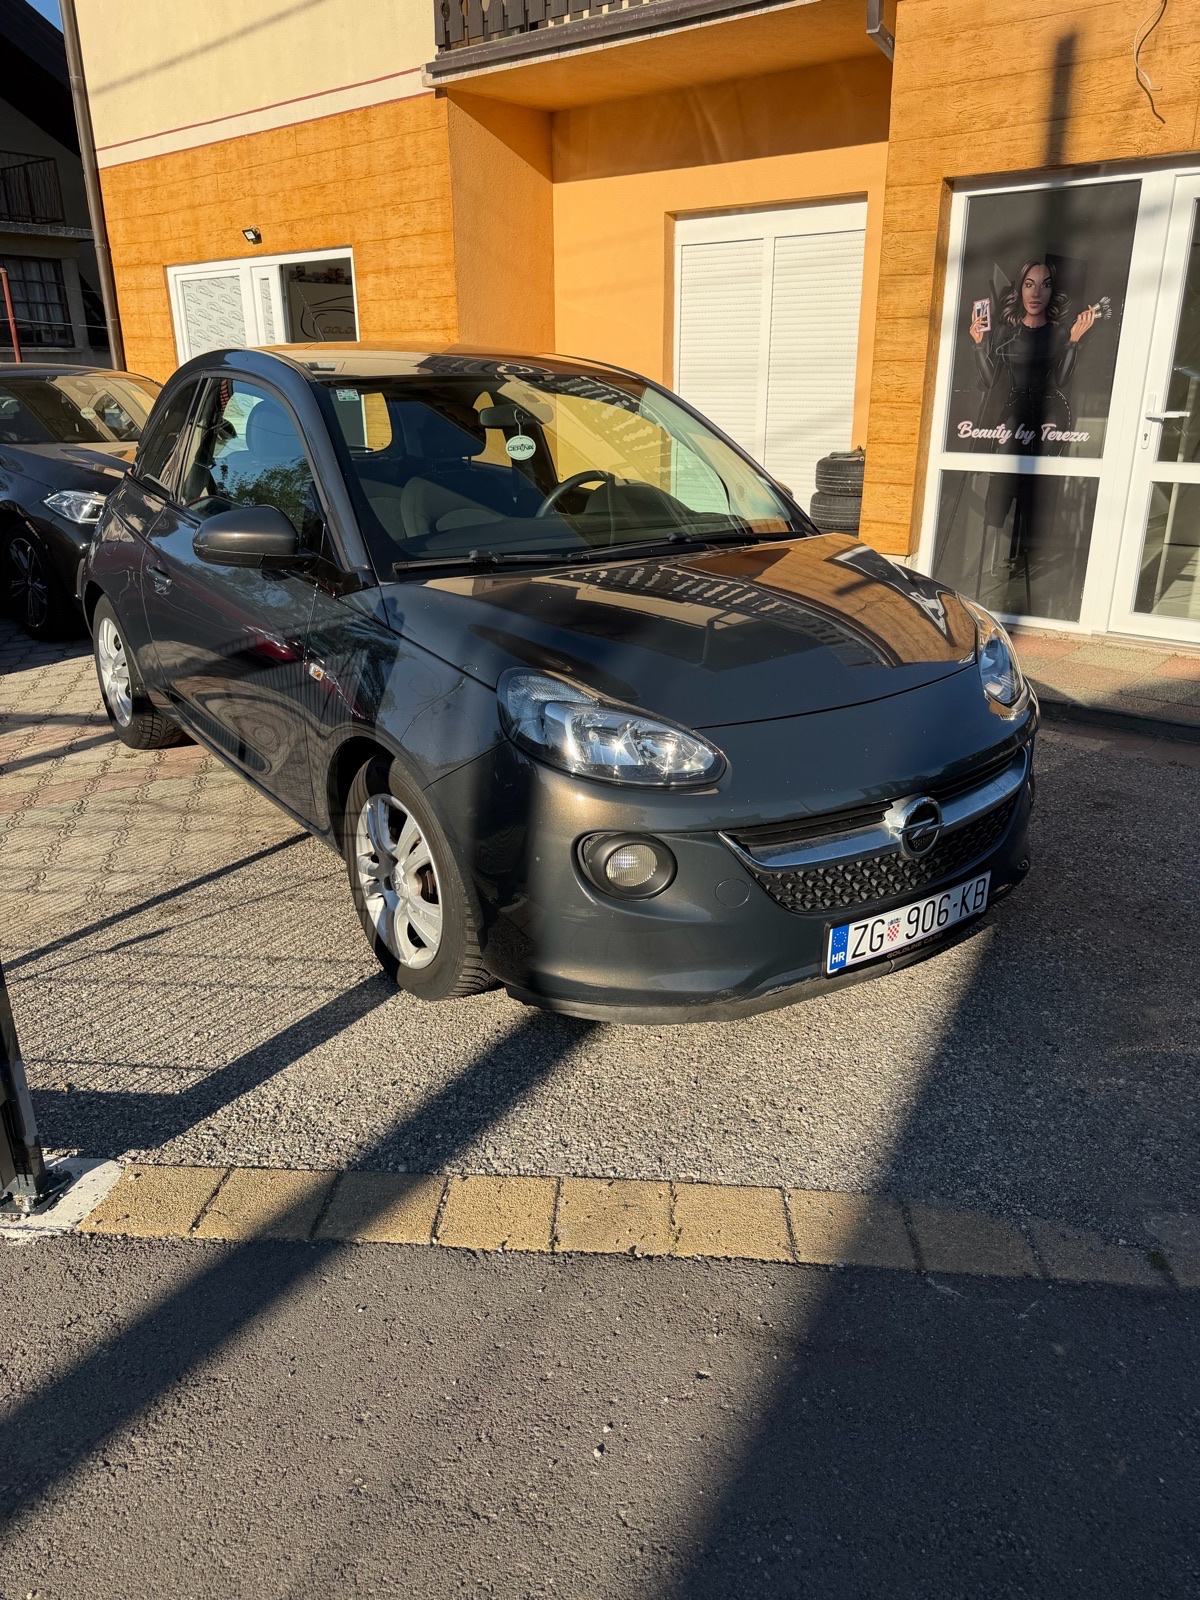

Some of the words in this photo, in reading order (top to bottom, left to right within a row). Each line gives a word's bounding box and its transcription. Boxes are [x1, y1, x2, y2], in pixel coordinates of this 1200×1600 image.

[957, 420, 1013, 445] Beauty
[1014, 423, 1037, 445] by
[1040, 423, 1091, 442] Tereza
[851, 918, 886, 959] ZG
[905, 877, 987, 940] 906-KB
[832, 951, 845, 964] HR
